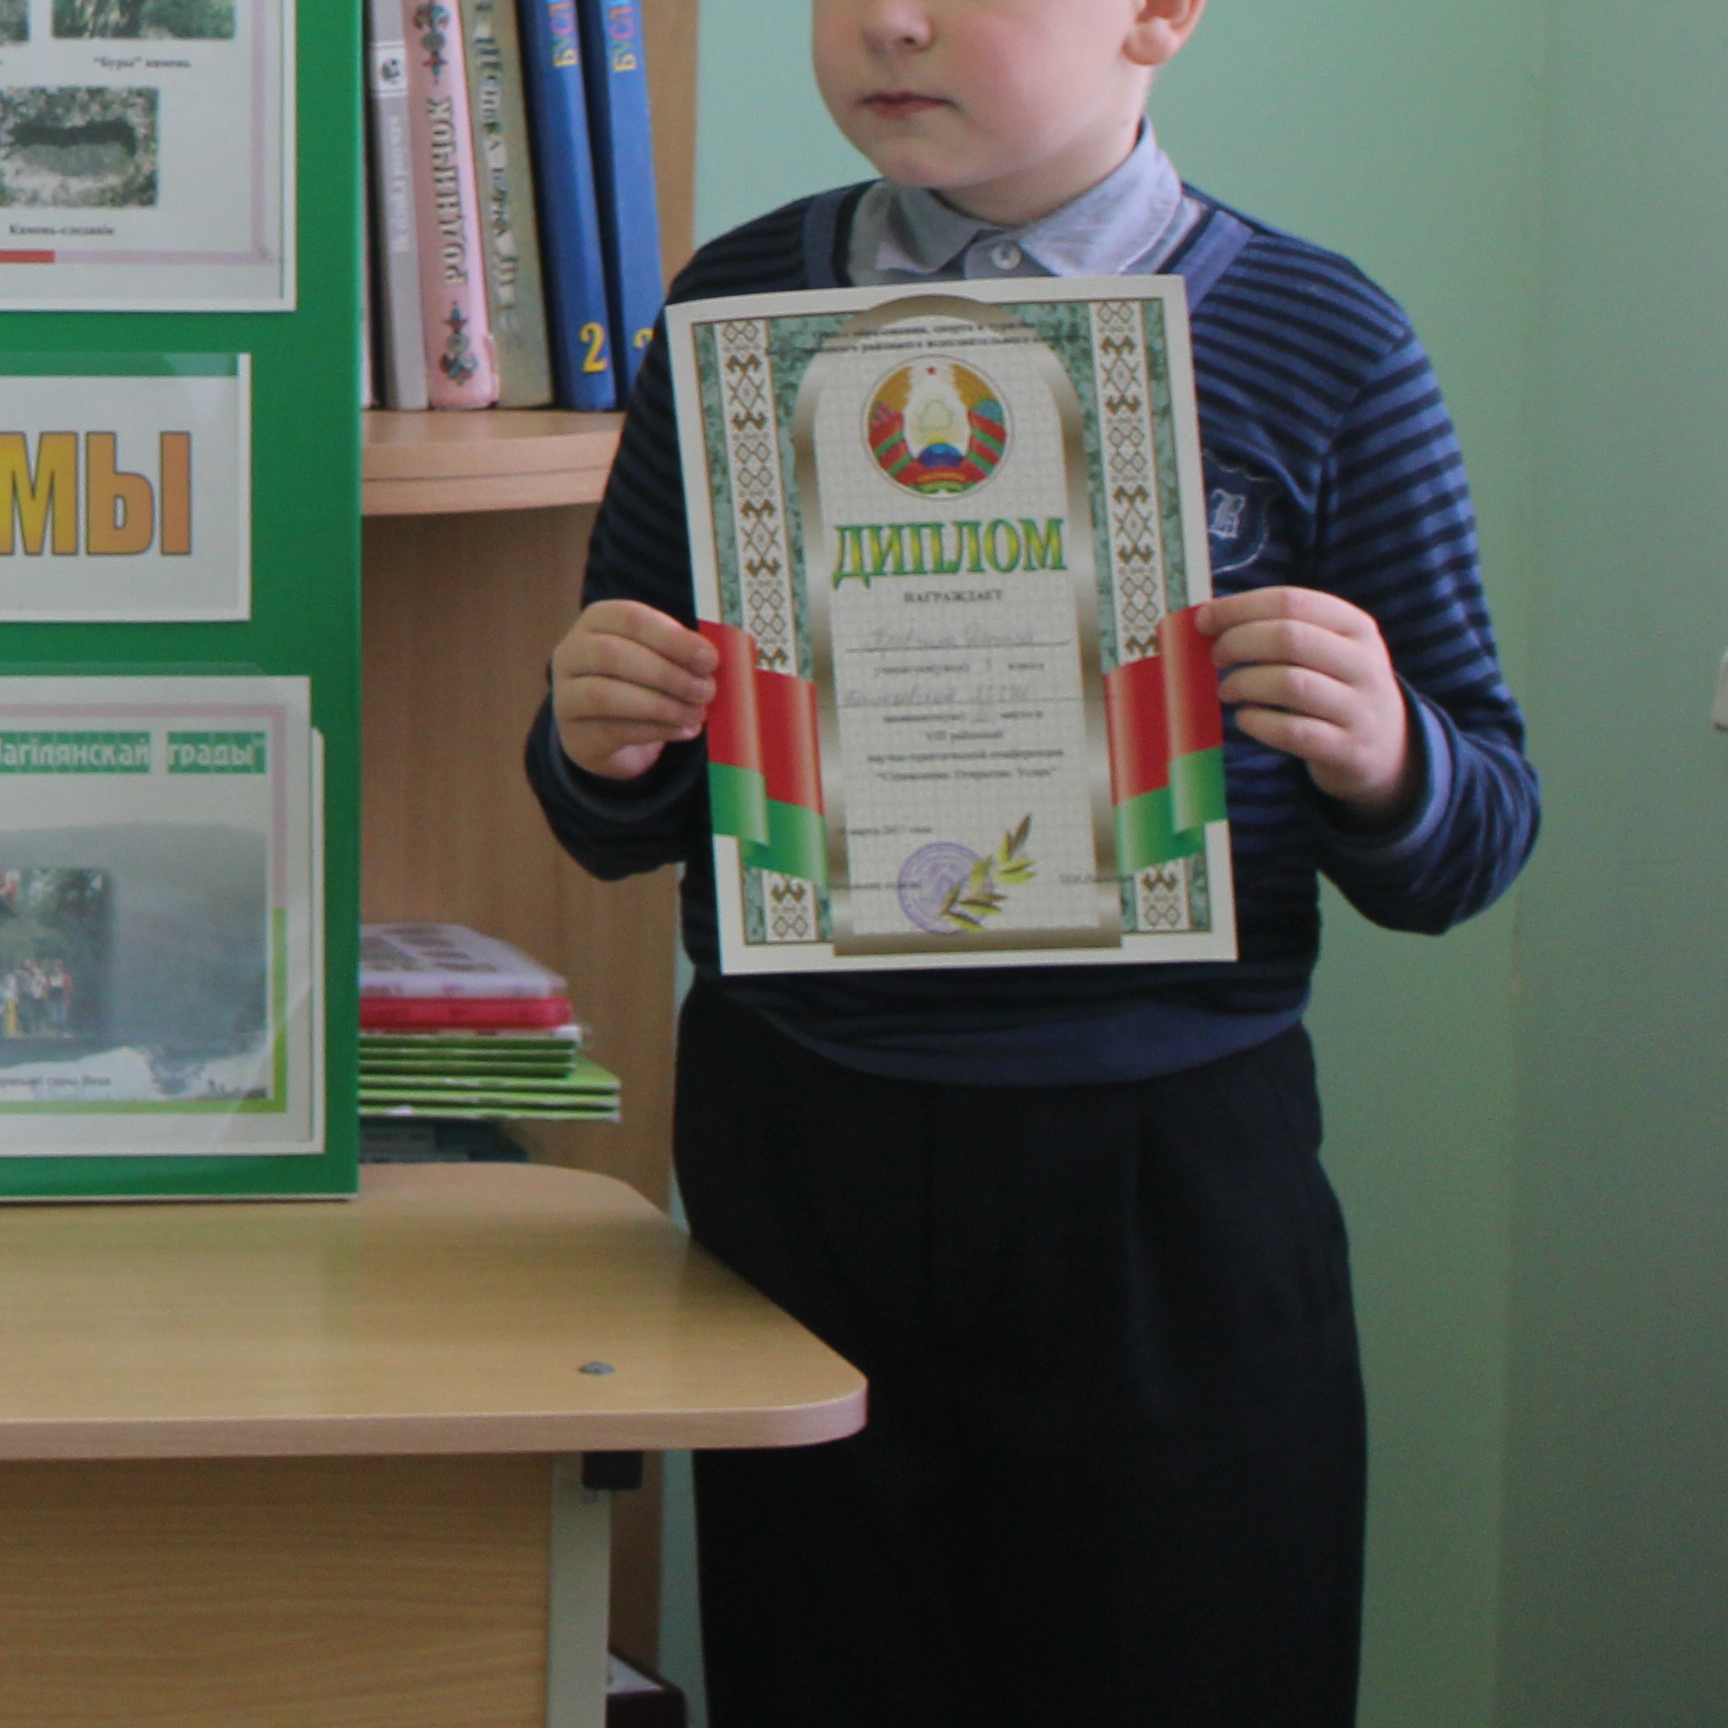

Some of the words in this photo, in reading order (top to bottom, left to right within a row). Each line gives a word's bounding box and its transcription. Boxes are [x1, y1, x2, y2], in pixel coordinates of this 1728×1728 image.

[427, 97, 469, 287] РОДНИЧОК
[579, 321, 609, 373] 2
[832, 517, 1067, 590] ДИПЛОМ
